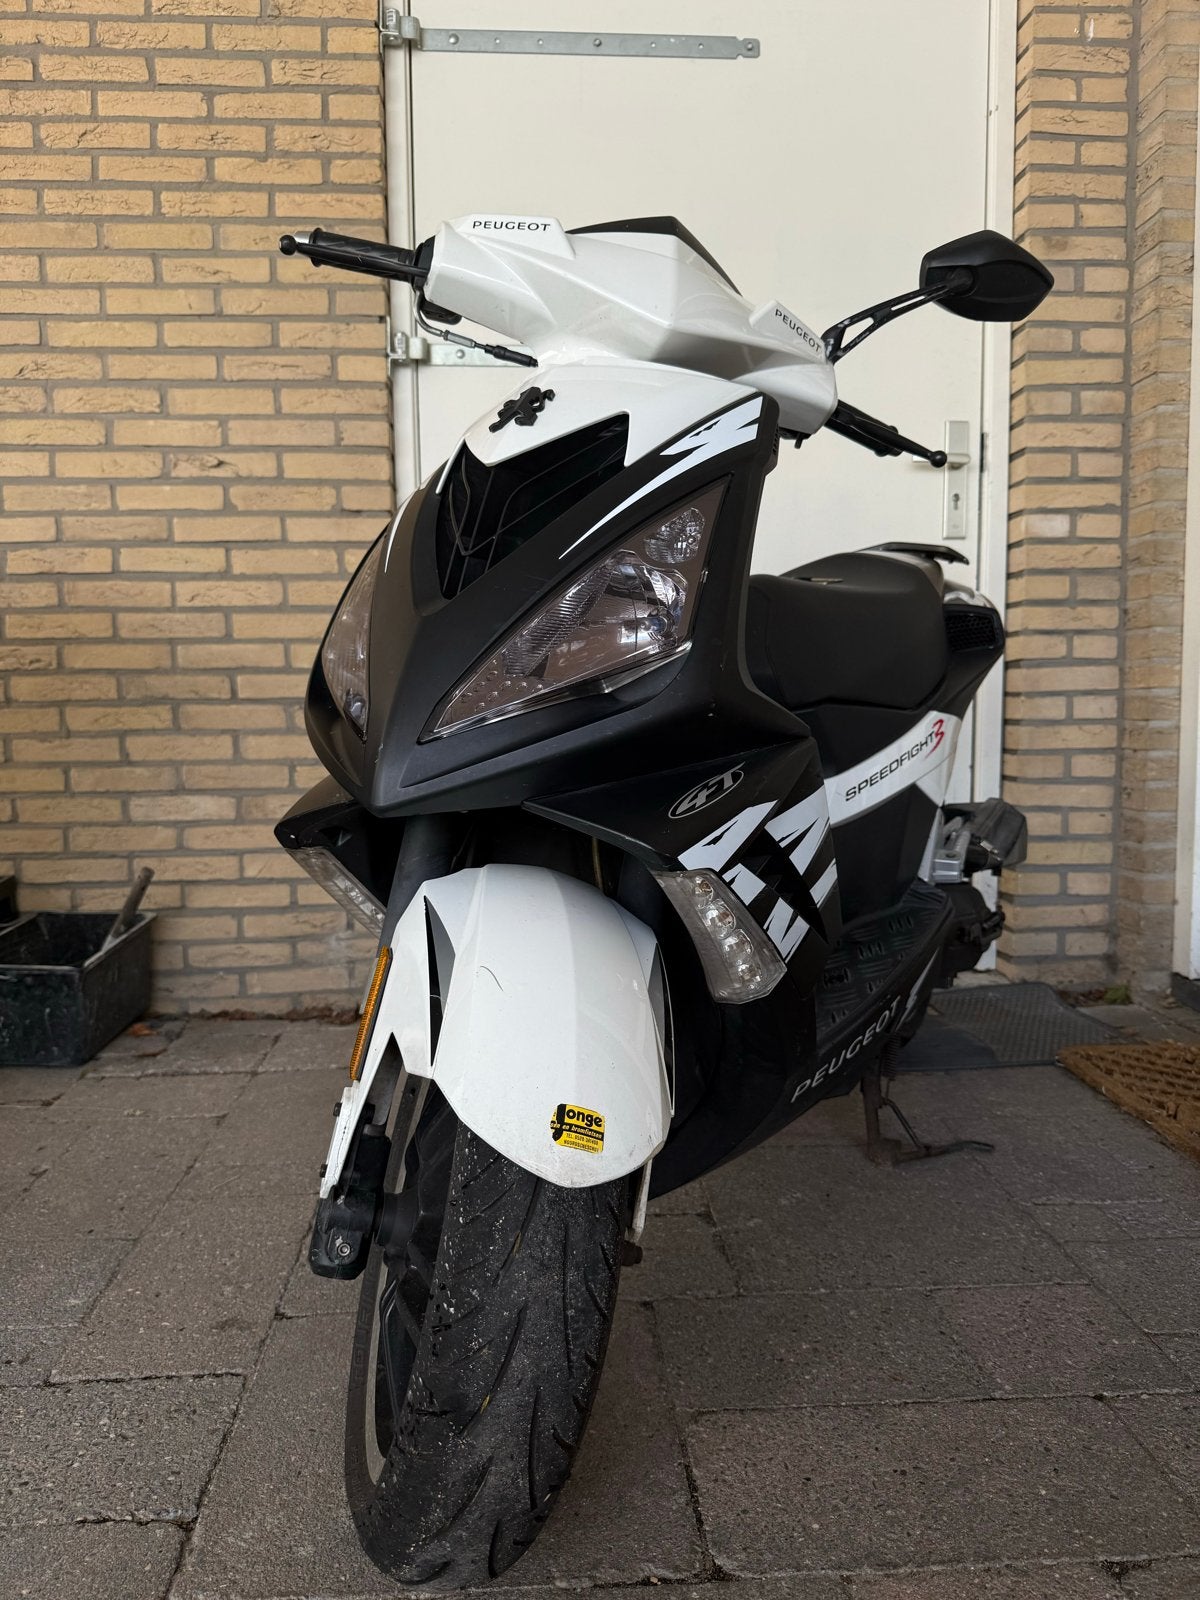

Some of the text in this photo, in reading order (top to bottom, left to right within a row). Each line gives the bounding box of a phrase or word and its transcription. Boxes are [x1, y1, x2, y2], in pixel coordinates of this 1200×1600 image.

[472, 220, 552, 232] PEUGEOT
[775, 308, 822, 352] PEUGEOT
[790, 995, 901, 1104] PEUGEOT
